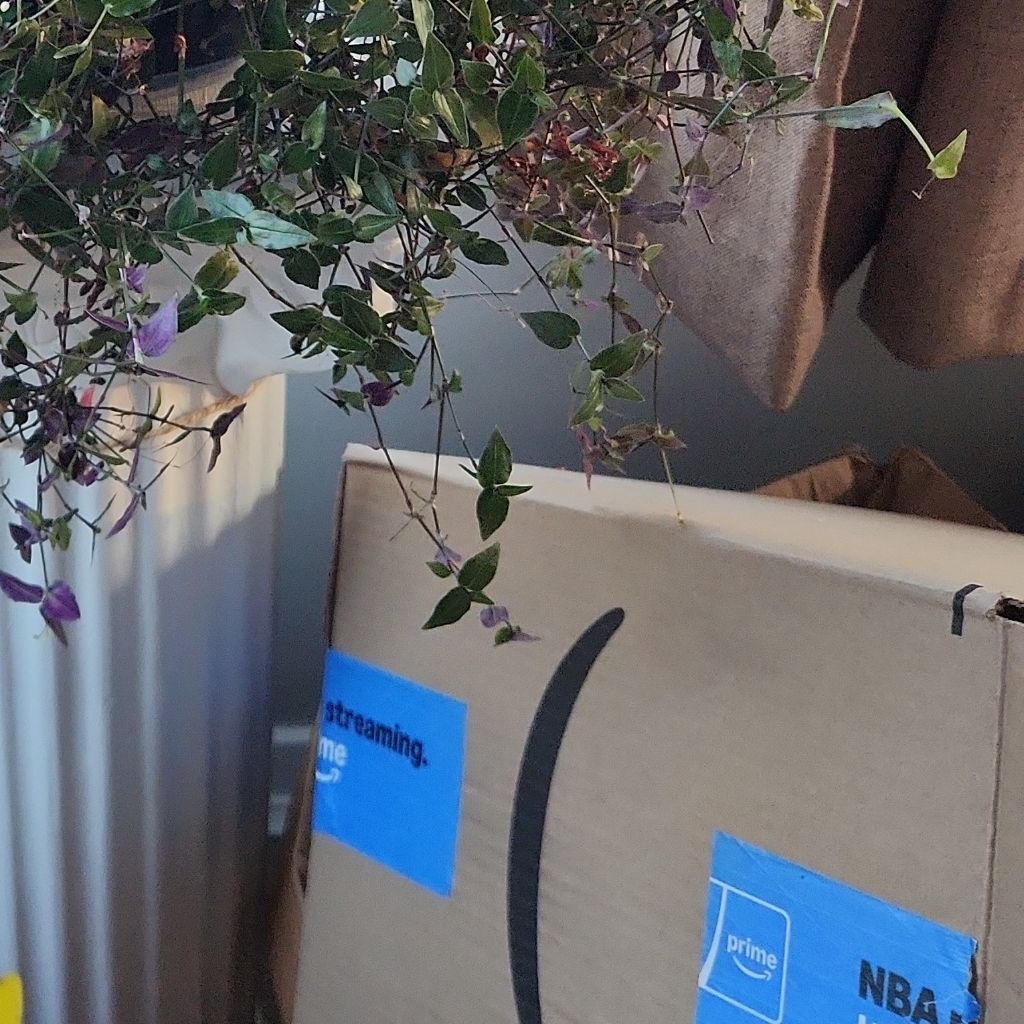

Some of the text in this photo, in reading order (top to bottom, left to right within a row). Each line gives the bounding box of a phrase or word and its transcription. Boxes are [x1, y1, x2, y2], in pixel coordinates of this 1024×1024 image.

[325, 700, 428, 768] streaming.
[726, 934, 778, 970] prime
[858, 959, 939, 1024] NBA
